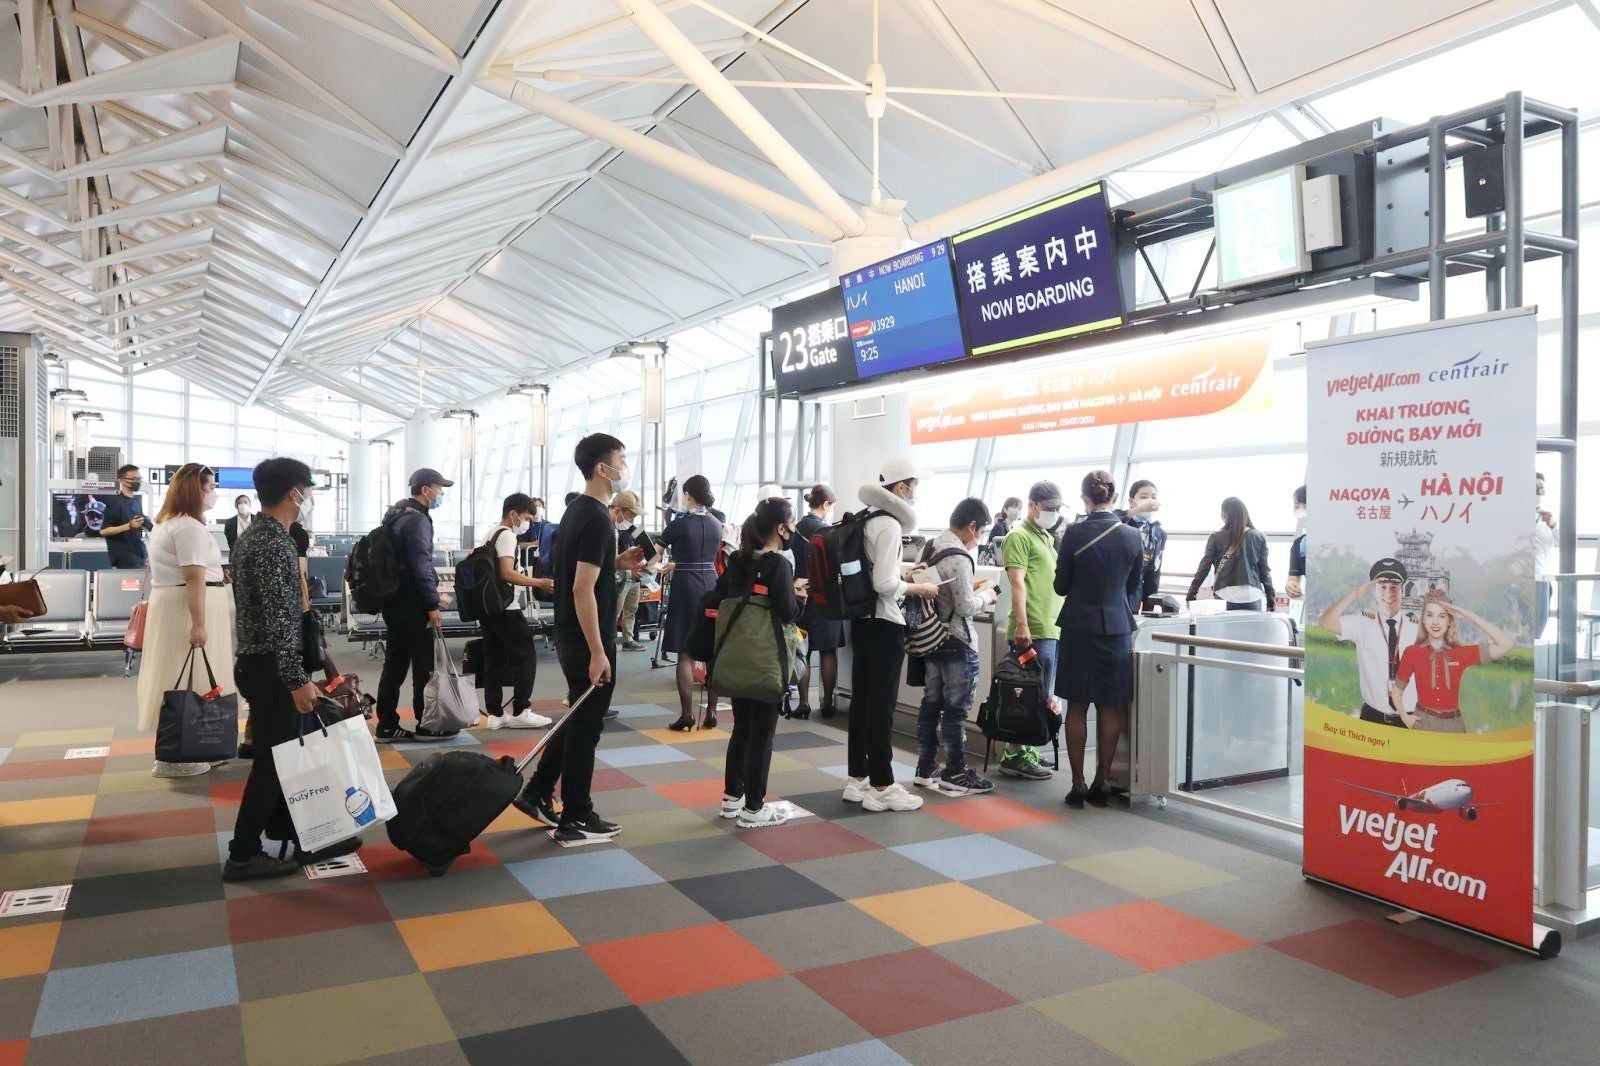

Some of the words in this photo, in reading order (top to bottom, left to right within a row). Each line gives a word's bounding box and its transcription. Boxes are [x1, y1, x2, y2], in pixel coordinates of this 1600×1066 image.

[879, 262, 892, 276] NOW
[893, 251, 924, 271] BOARDING
[967, 226, 1097, 293] 搭乗案内中
[847, 291, 868, 310] ハノイ
[895, 272, 926, 295] HANOI
[981, 297, 1013, 322] NOW
[1015, 277, 1095, 314] BOARDING
[808, 316, 848, 347] 搭乗口
[780, 327, 809, 373] 23
[810, 346, 837, 367] Gate
[860, 346, 879, 362] 9:25
[1429, 358, 1510, 383] centrair
[1170, 372, 1242, 398] centrair
[1356, 406, 1394, 423] KHAI
[1398, 399, 1470, 419] TRƯƠNG
[1347, 424, 1405, 446] ĐƯỜNG
[1409, 425, 1443, 442] BAY
[1446, 418, 1482, 438] MỚI
[1380, 449, 1438, 468] 新規就航
[1329, 488, 1390, 502] NAGOYA
[1420, 473, 1453, 496] HÀ
[1458, 471, 1504, 502] NỘI
[1356, 505, 1392, 521] 名古屋
[1420, 502, 1473, 525] ハノイ
[1324, 722, 1338, 735] Bay
[1367, 737, 1386, 748] ngay
